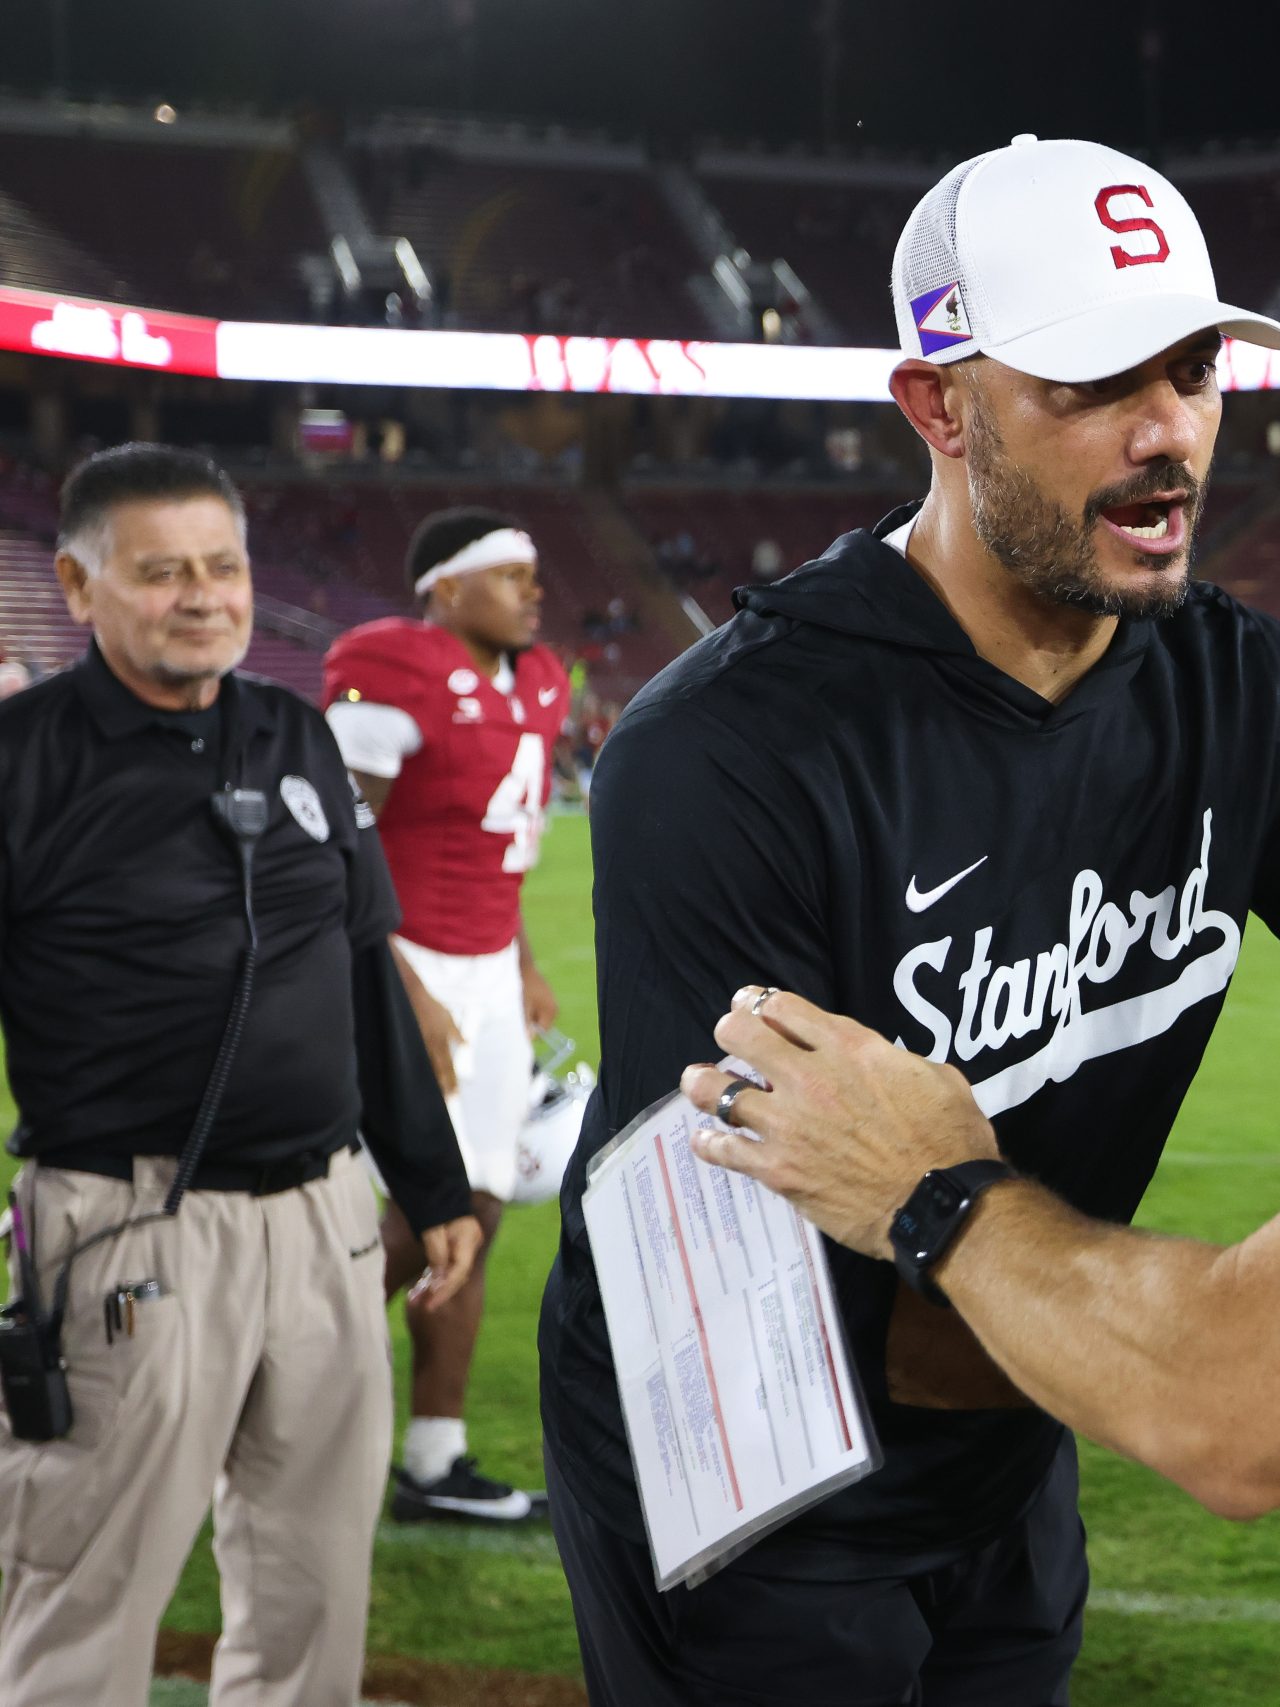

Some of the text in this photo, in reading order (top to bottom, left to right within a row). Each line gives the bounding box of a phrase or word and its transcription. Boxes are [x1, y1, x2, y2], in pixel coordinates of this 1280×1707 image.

[1094, 183, 1170, 270] S
[480, 731, 546, 873] 4
[893, 807, 1242, 1085] Stanford
